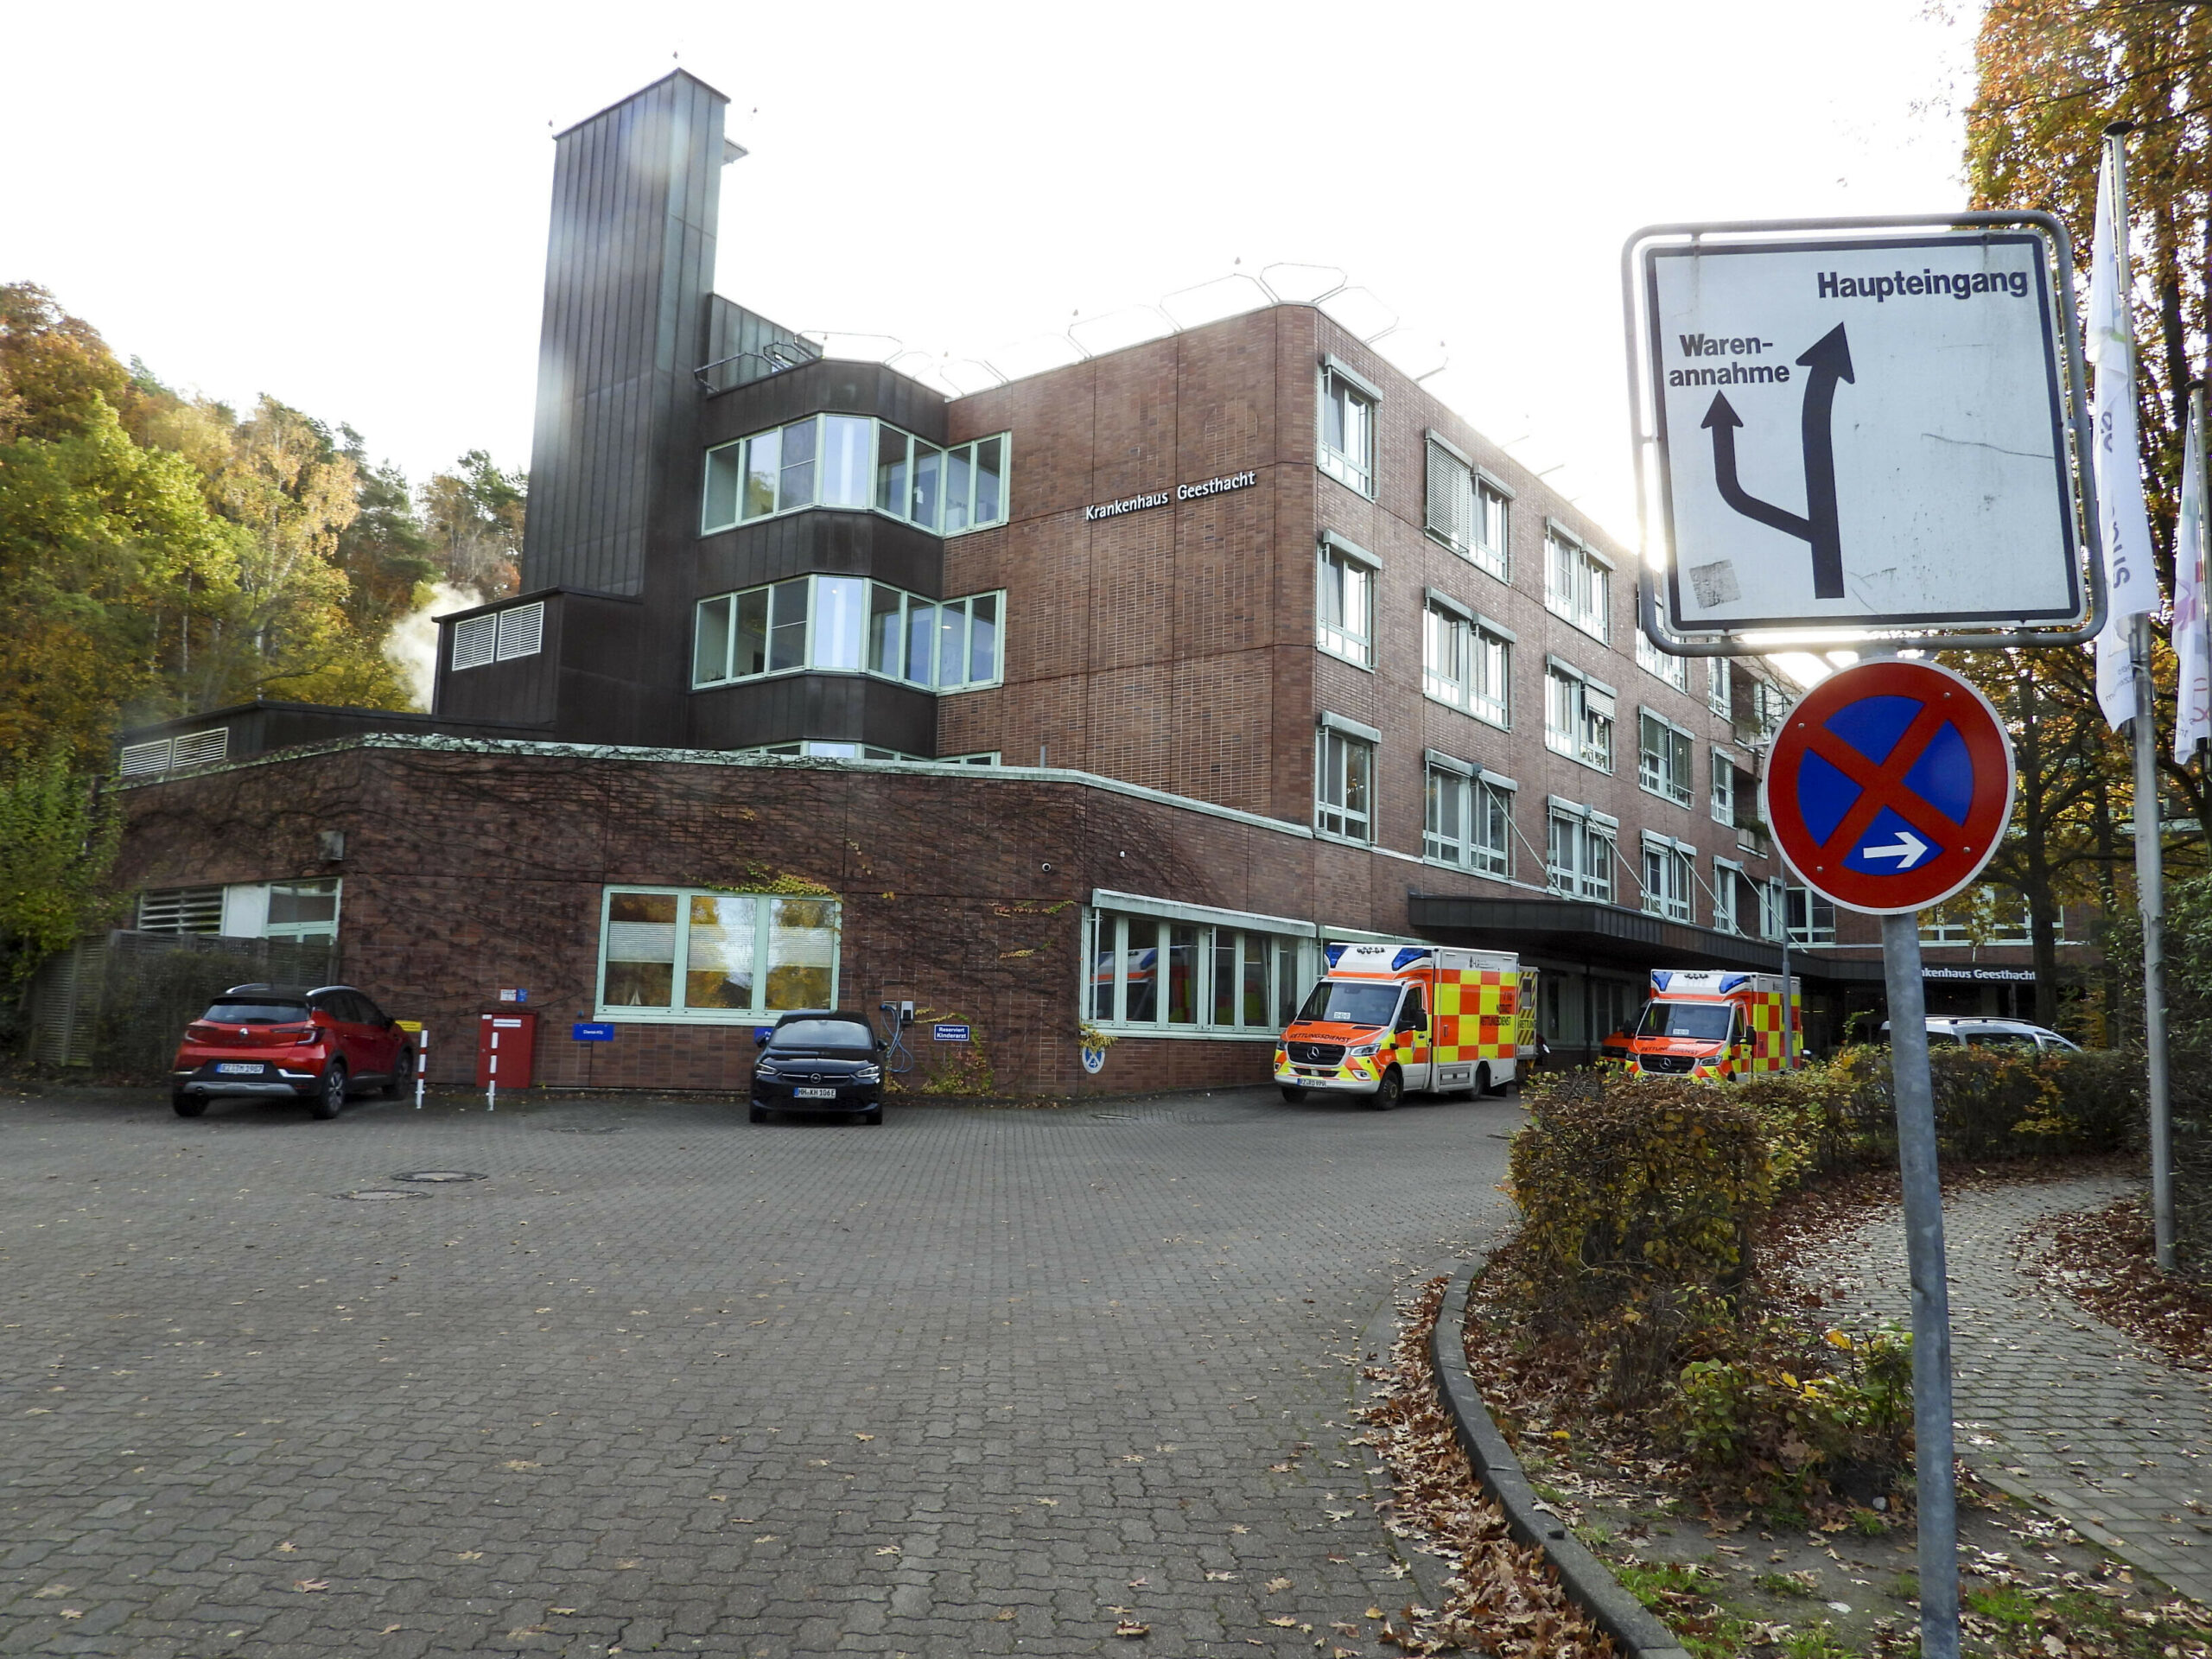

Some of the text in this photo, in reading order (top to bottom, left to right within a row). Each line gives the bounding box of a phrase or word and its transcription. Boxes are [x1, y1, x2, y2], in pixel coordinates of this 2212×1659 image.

[1817, 269, 2028, 302] Haupteingang
[1679, 334, 1773, 357] Waren-
[1669, 361, 1790, 387] annahme
[1085, 470, 1256, 520] Krankenhaus Geesthacht
[1289, 1033, 1351, 1043] RETTUNGSDIENST
